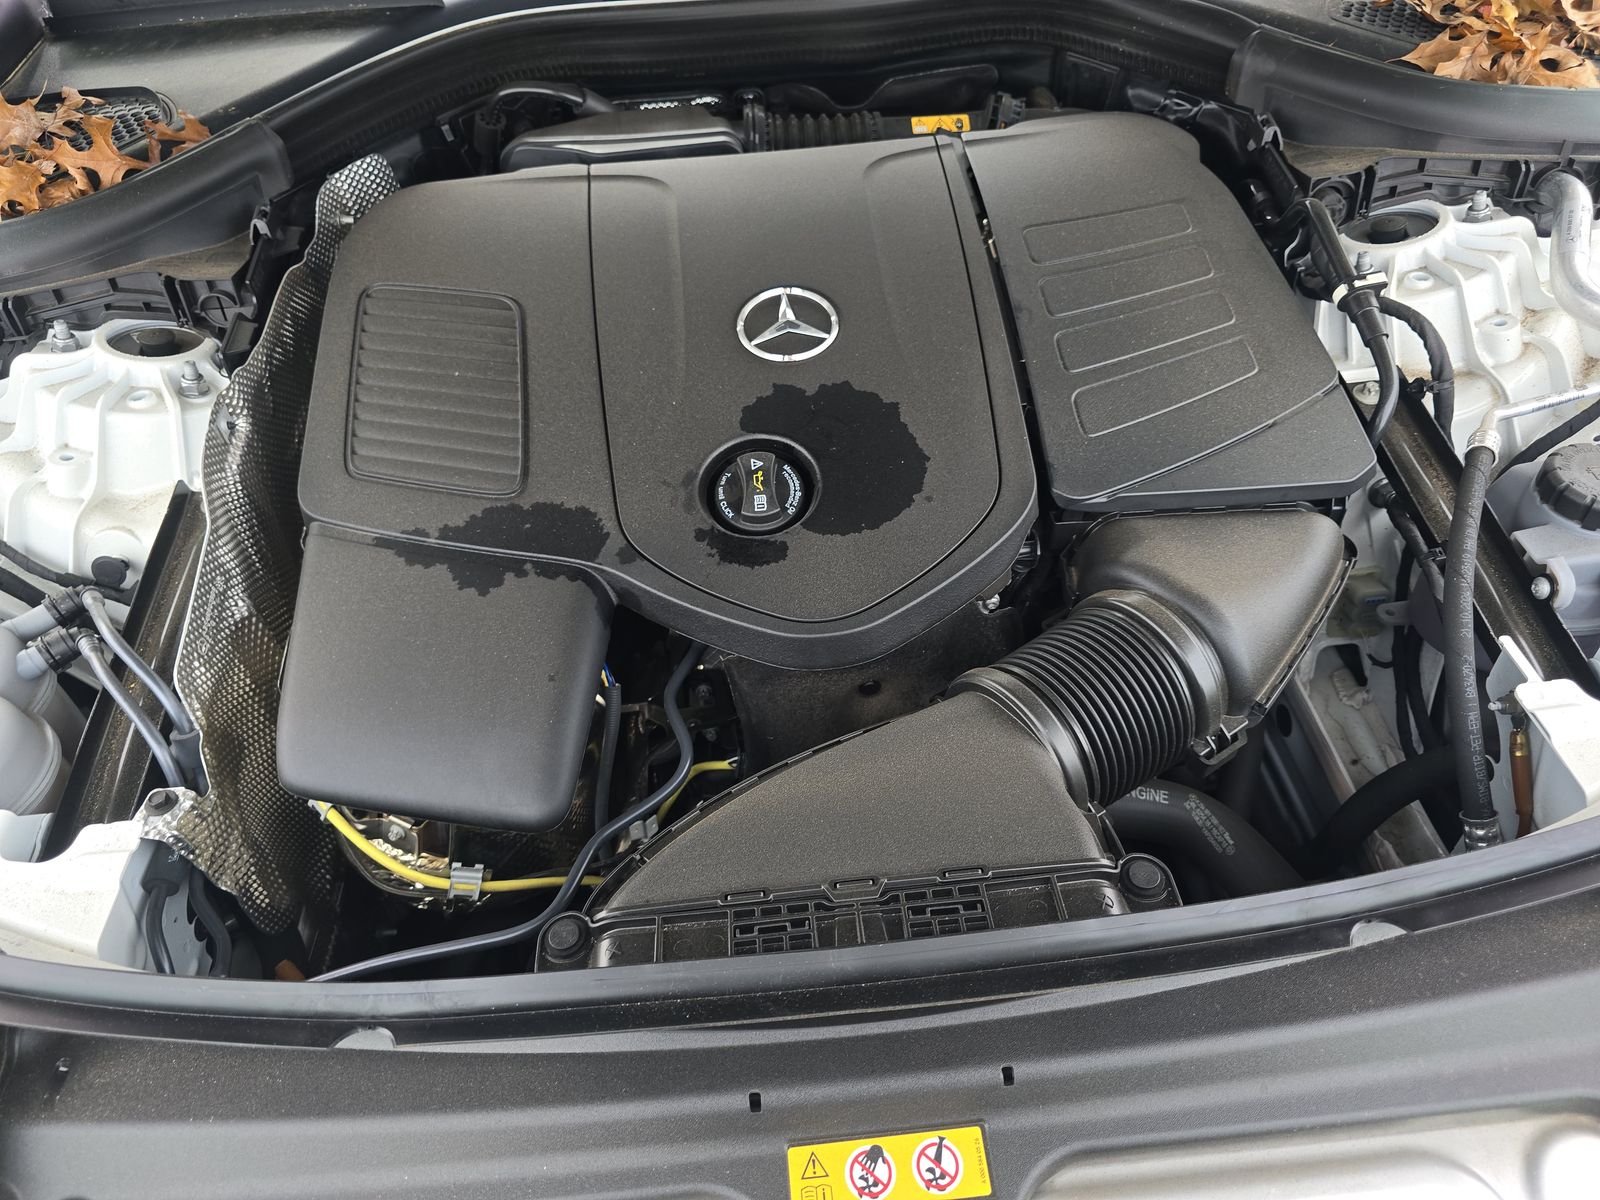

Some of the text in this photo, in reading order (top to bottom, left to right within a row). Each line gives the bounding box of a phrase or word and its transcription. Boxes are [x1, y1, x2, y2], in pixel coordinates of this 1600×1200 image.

[720, 473, 731, 485] Turn
[782, 464, 801, 506] Mercedes-Benz
[782, 471, 795, 508] recommended
[720, 501, 734, 518] CLICK
[1126, 786, 1169, 804] NGINE
